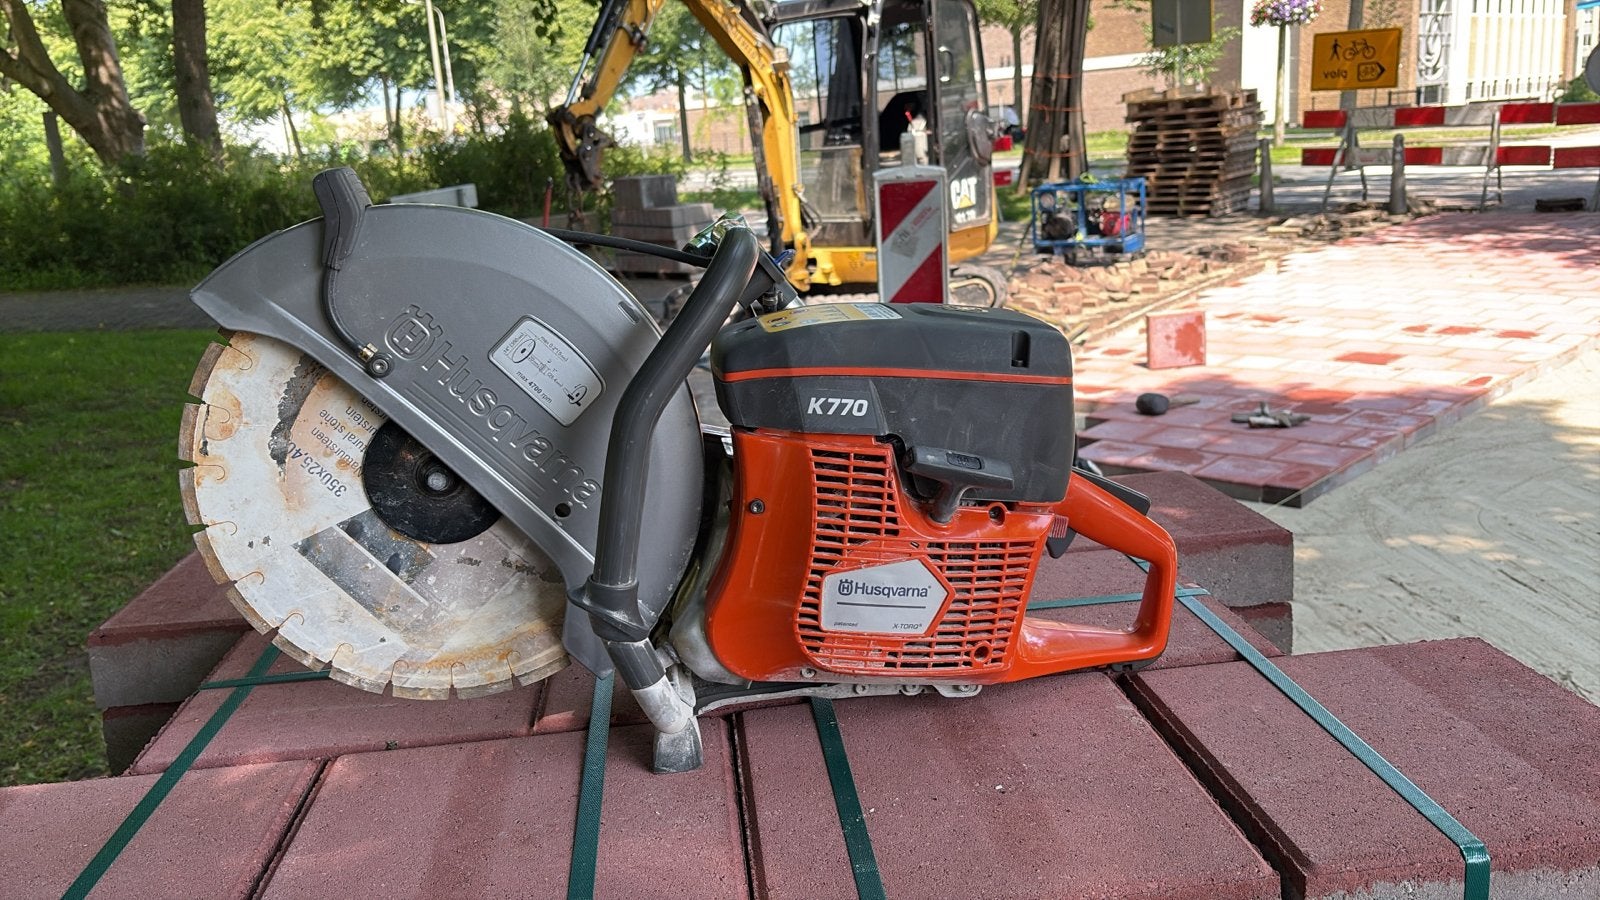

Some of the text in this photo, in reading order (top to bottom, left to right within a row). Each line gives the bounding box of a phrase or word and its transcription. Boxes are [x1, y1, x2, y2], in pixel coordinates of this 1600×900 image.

[1322, 68, 1348, 80] volg
[950, 176, 977, 210] CAT
[516, 371, 553, 404] max 4700 rpm
[807, 397, 868, 417] K770
[319, 409, 367, 453] tural stone
[421, 341, 602, 509] Husqvarna
[311, 427, 364, 477] Natuursteen
[854, 582, 928, 598] Husqvarna
